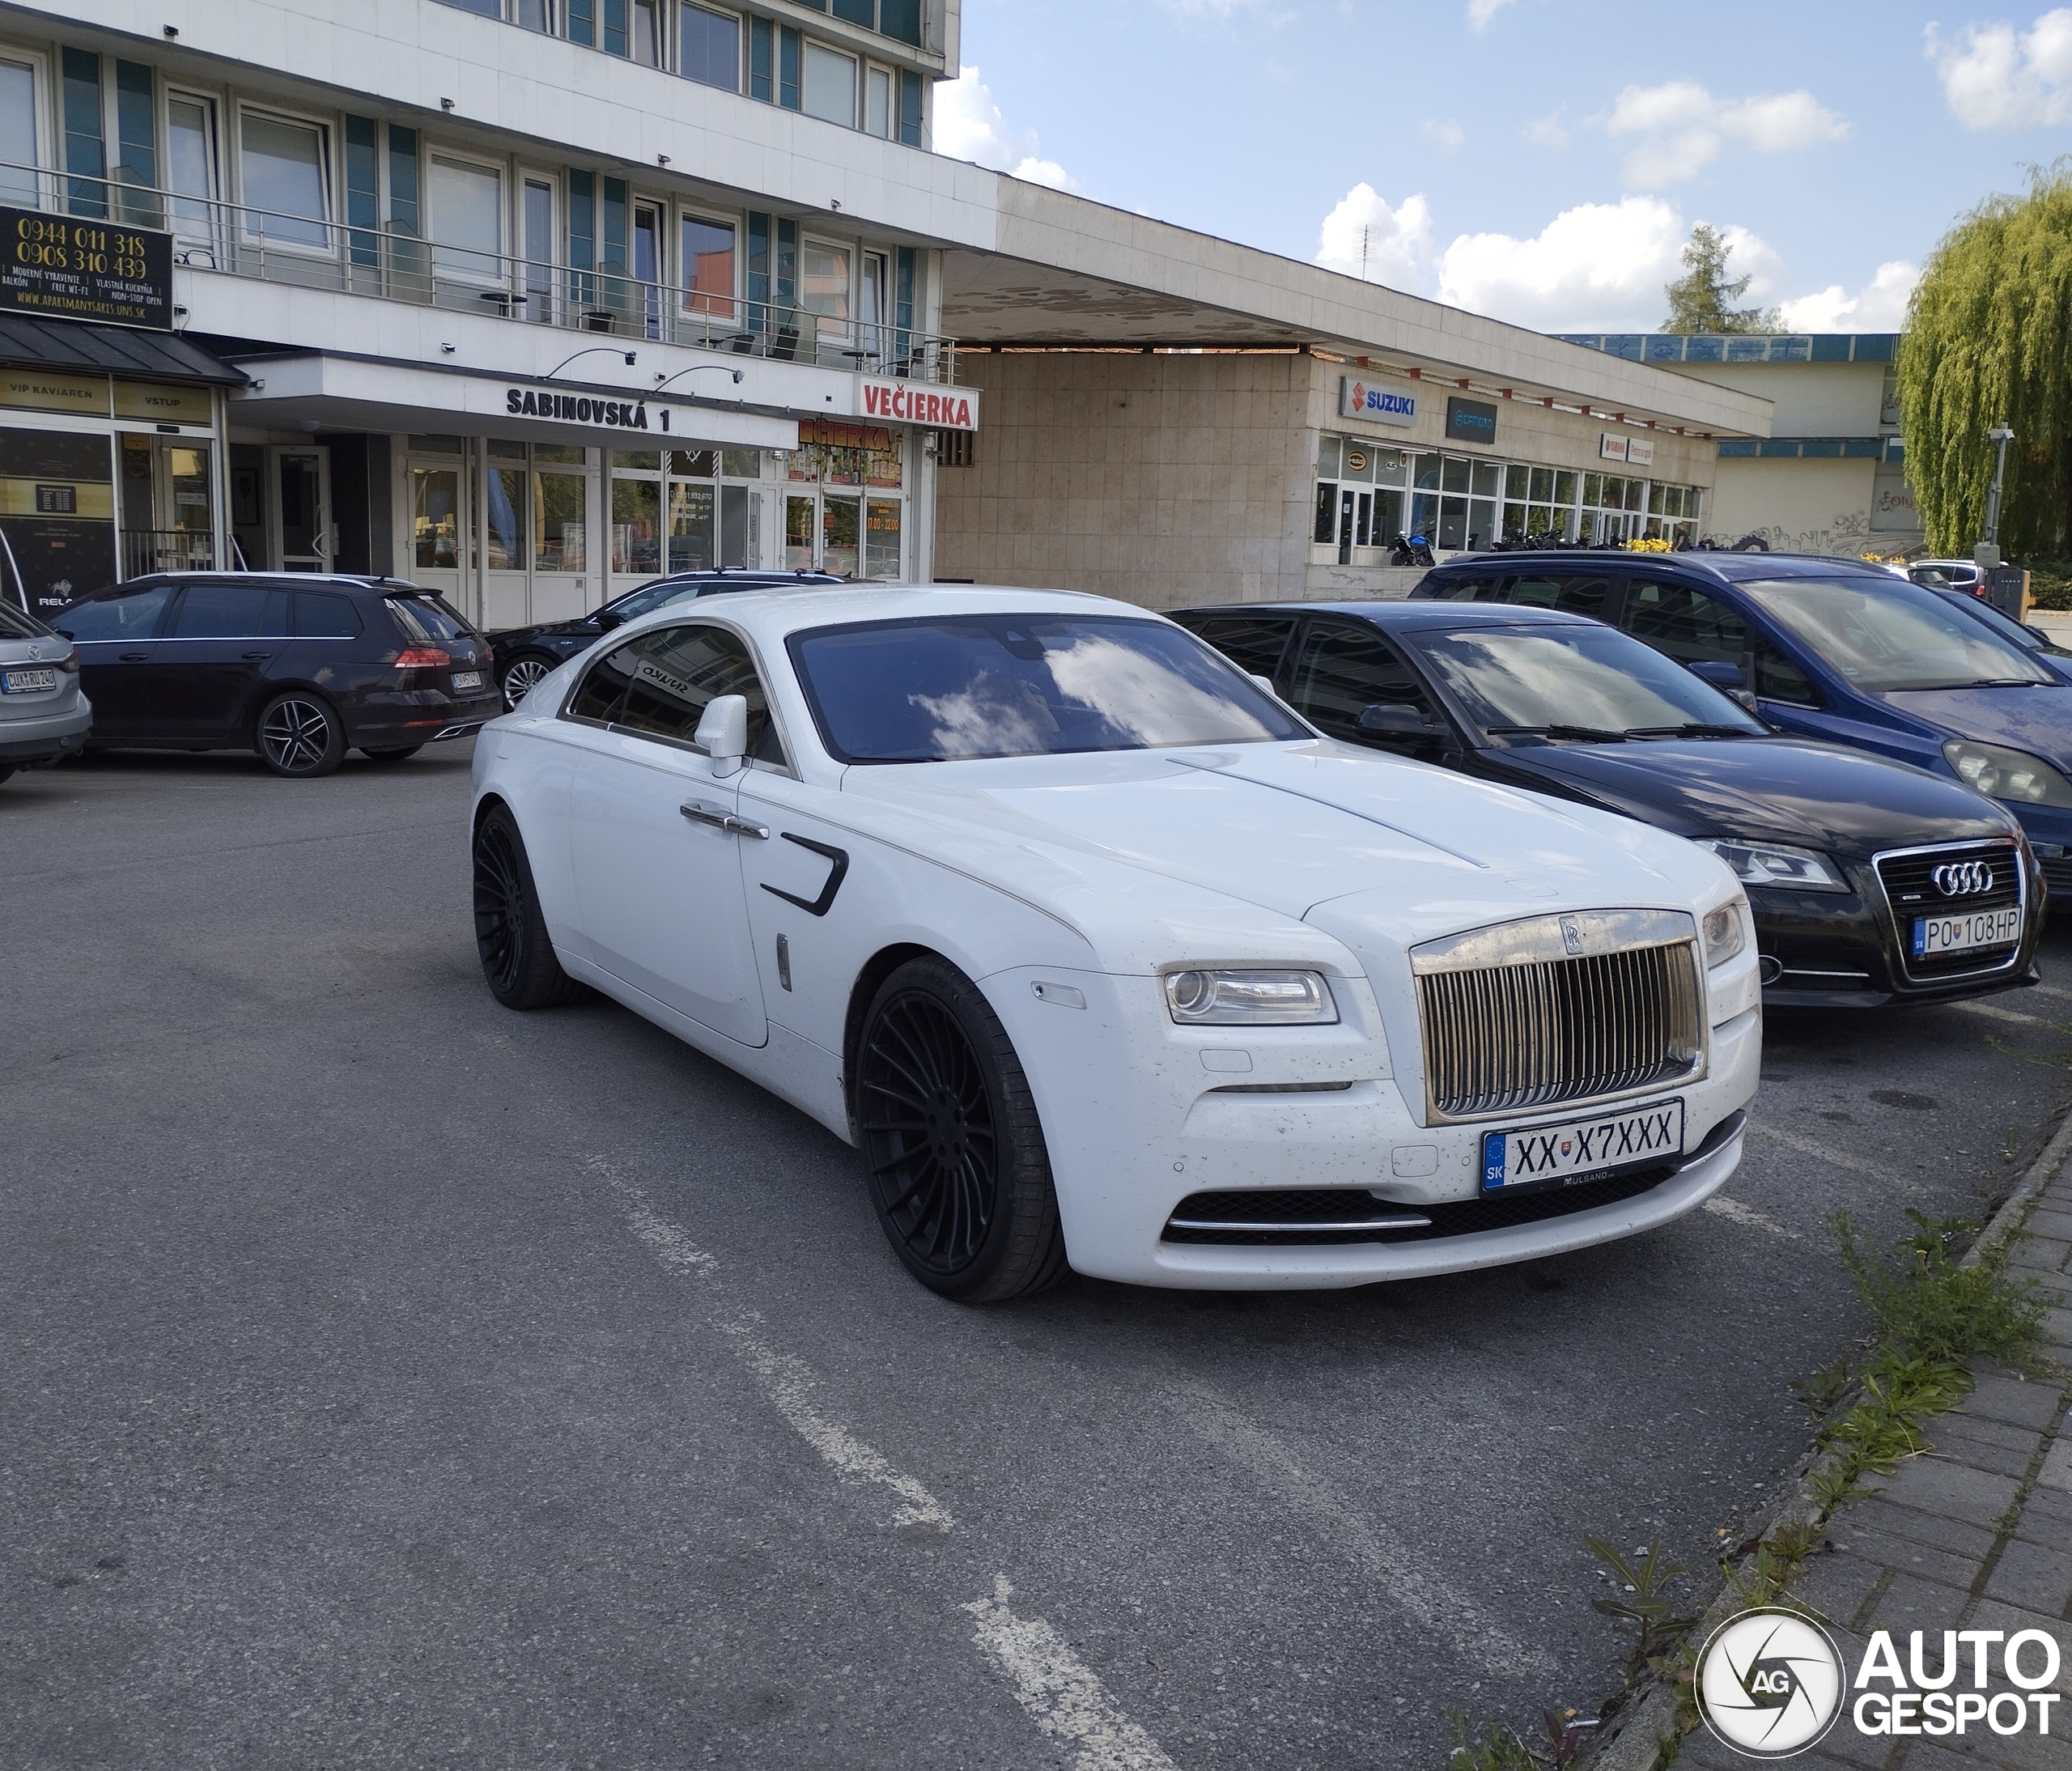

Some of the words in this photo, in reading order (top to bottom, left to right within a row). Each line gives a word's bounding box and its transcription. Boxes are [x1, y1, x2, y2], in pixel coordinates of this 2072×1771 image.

[18, 218, 66, 244] 0944
[75, 227, 105, 251] 011
[114, 234, 145, 257] 318
[17, 241, 67, 268] 0908
[74, 250, 108, 274] 310
[113, 257, 146, 279] 439
[45, 271, 80, 284] VYBAVENIE
[2, 275, 28, 287] BALKÓN
[52, 283, 66, 293] FREE
[69, 286, 89, 295] WI-FI
[111, 291, 144, 304] NON-STOP
[146, 296, 162, 305] OPEN
[10, 383, 29, 393] VIP
[33, 385, 92, 398] KAVIAREŇ
[145, 397, 180, 407] VSTUP
[507, 389, 648, 429] SABINOVSKÁ
[660, 410, 669, 431] 1
[864, 384, 971, 427] VEČIERKA
[1367, 390, 1415, 416] SUZUKI
[1462, 414, 1492, 429] CFMOTO
[1891, 495, 1916, 509] Oly
[8, 673, 24, 687] CUX
[1928, 920, 1952, 949] PO
[1965, 911, 2018, 945] 108HP
[1915, 941, 1924, 949] SK
[1515, 1133, 1559, 1174] XX
[1574, 1111, 1673, 1165] X7XXX
[1487, 1165, 1502, 1180] SK
